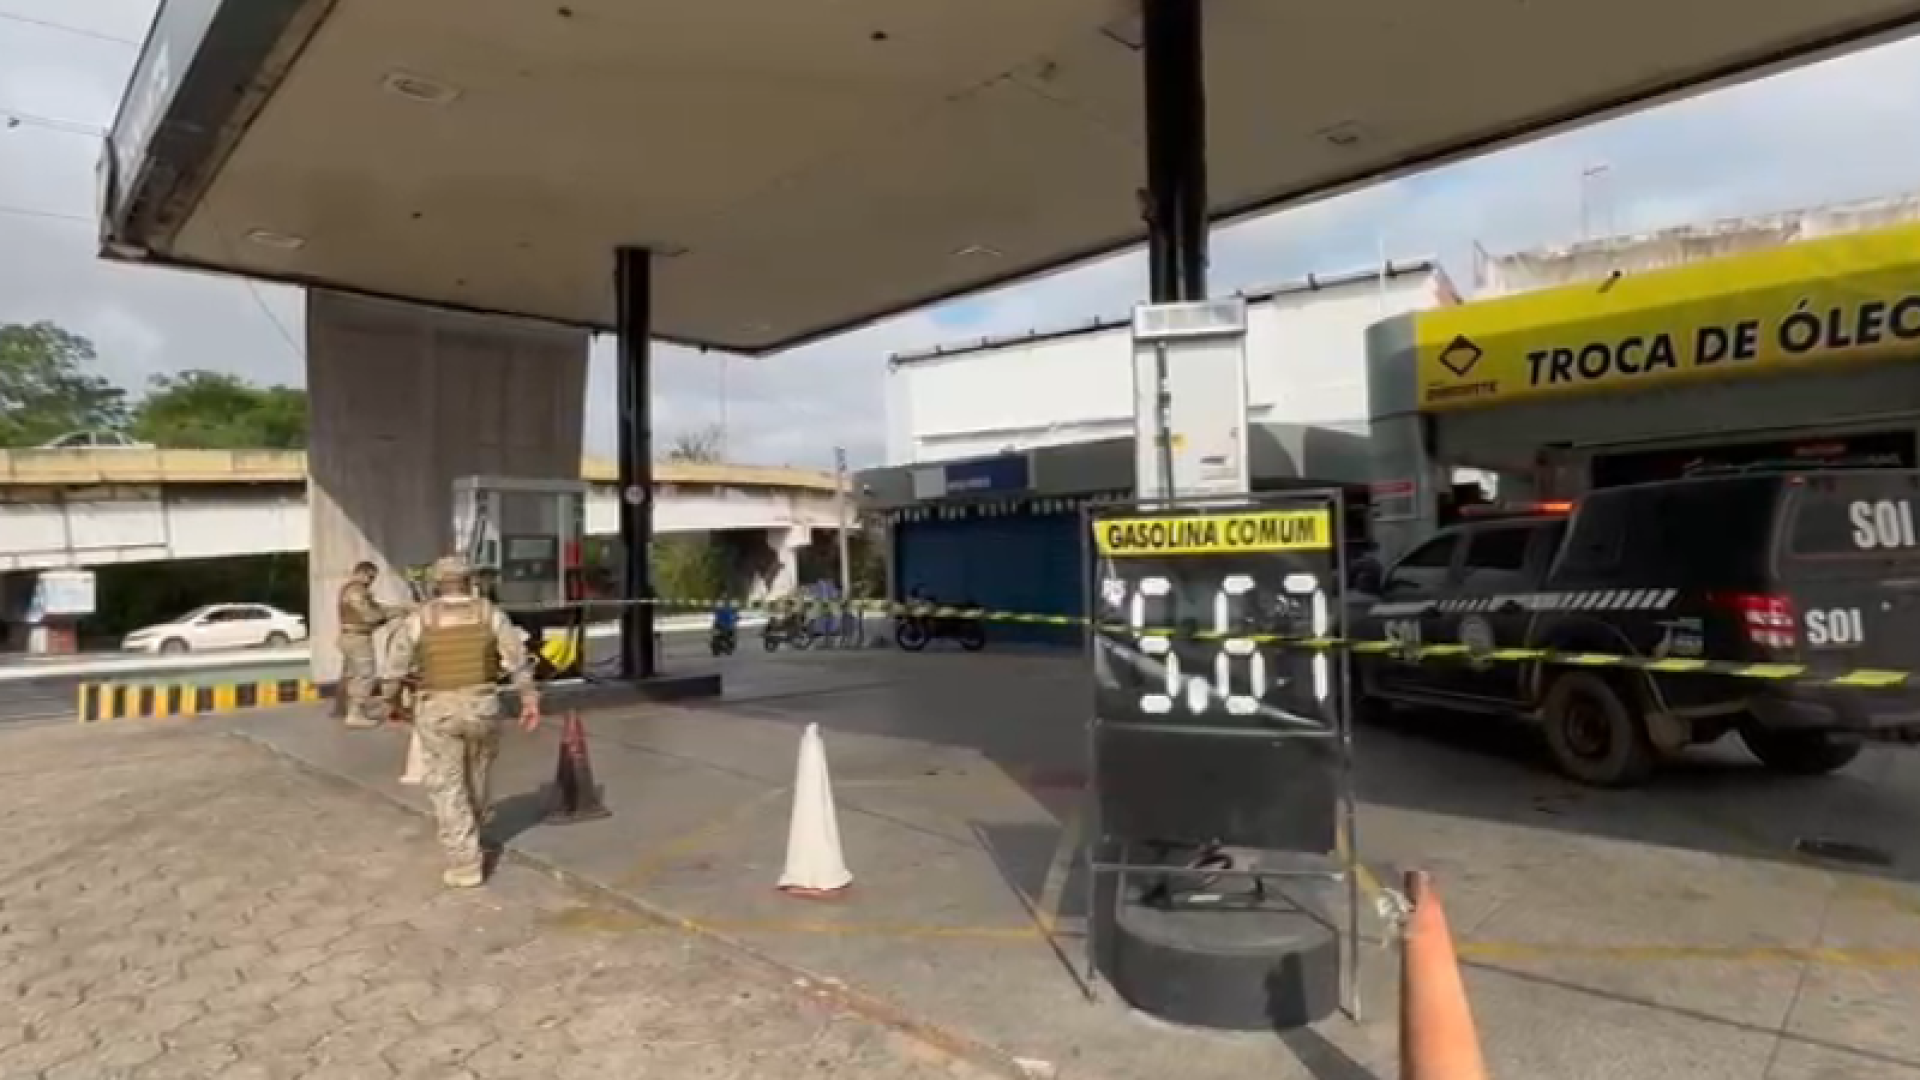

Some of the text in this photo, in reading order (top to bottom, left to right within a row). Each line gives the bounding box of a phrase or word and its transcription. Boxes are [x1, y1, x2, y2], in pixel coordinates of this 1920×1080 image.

[1526, 333, 1677, 387] TROCA
[1694, 320, 1760, 367] DE
[1108, 516, 1316, 548] GASOLINA COMUM
[1849, 500, 1915, 548] SOI
[1805, 608, 1864, 644] SOI
